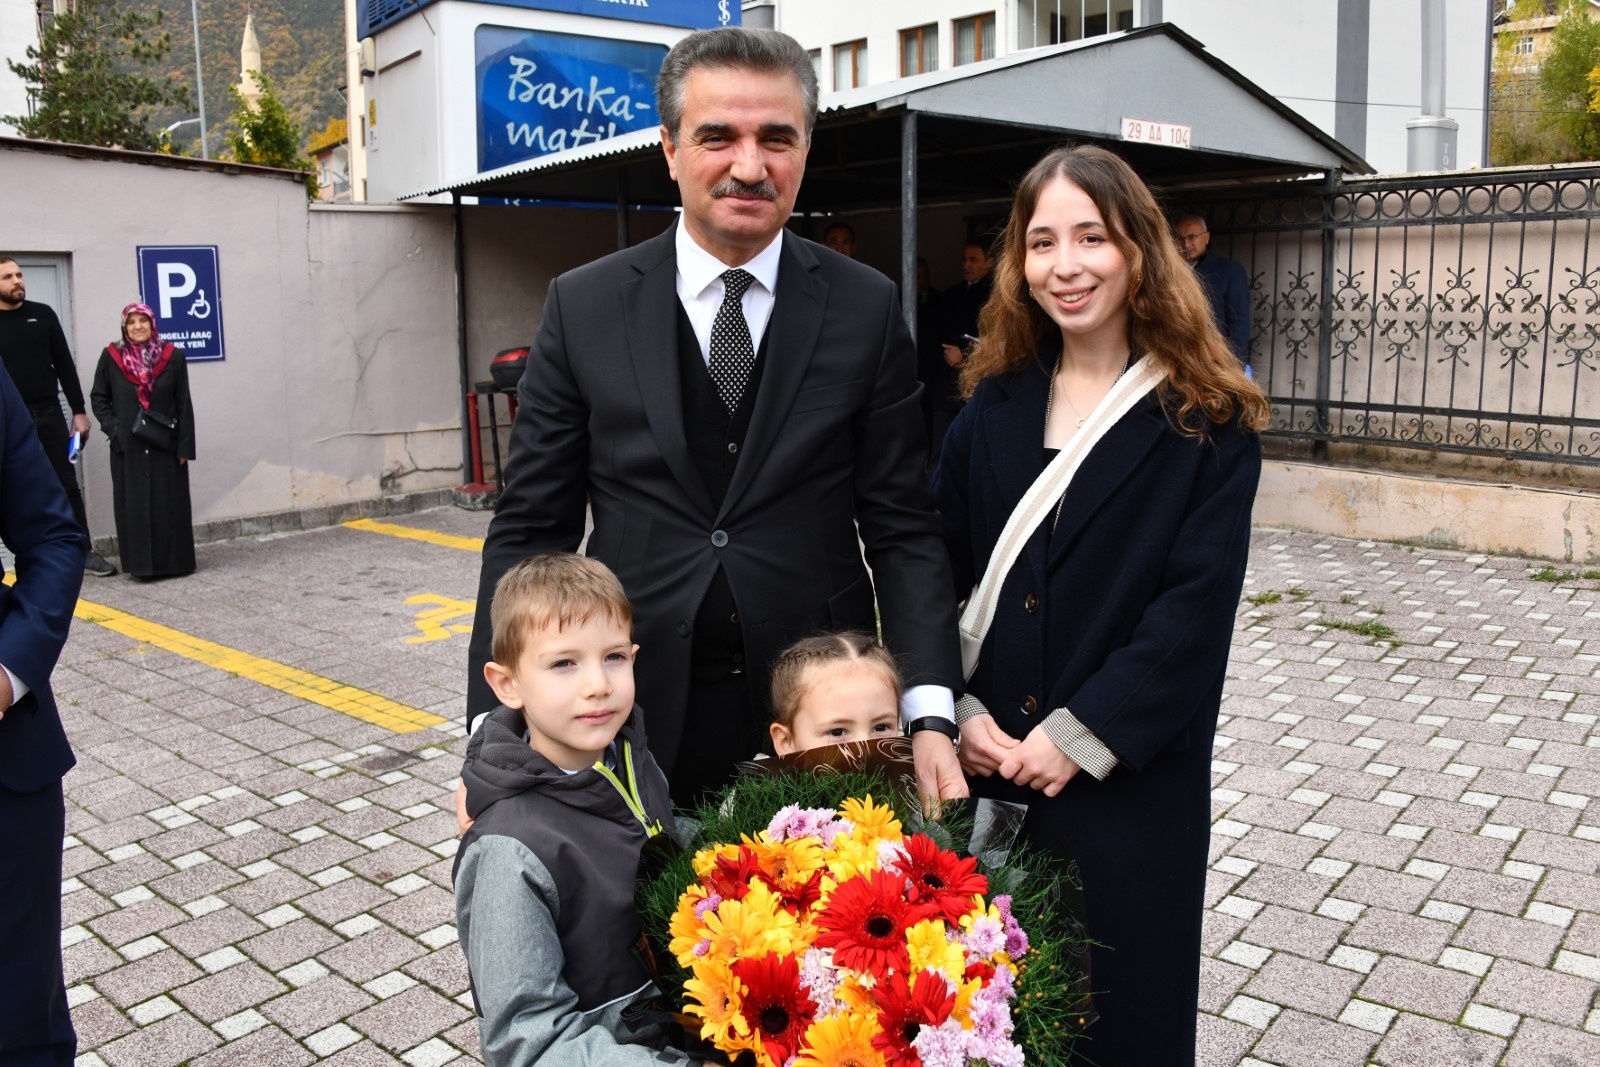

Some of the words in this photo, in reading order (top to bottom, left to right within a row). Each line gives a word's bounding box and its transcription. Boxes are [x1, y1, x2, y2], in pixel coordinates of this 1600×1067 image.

[508, 55, 651, 121] Banka-
[1127, 122, 1141, 140] 29
[1149, 124, 1162, 142] AA
[1170, 127, 1189, 146] 104
[156, 262, 197, 319] P
[187, 339, 206, 348] YERİ
[191, 331, 212, 340] ARAÇ
